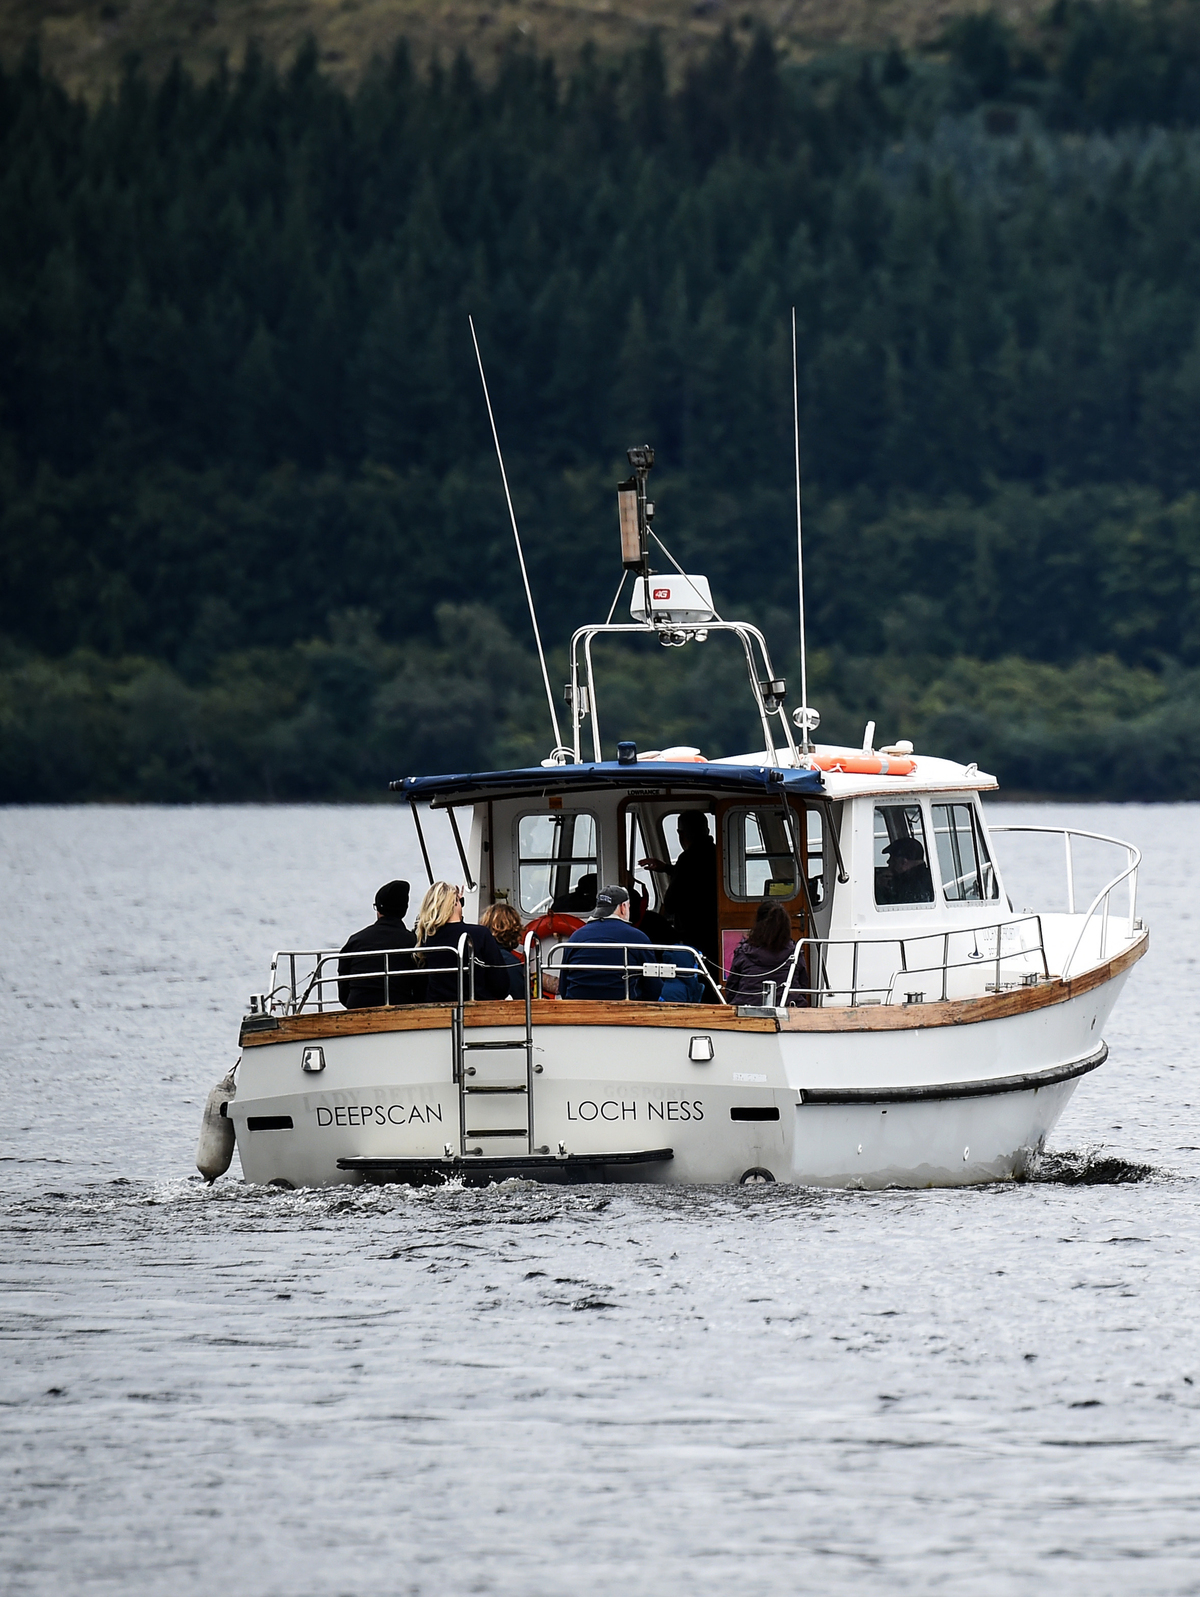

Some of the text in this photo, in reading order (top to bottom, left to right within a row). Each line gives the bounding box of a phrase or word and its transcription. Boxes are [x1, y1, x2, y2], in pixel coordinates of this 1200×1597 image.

[655, 590, 668, 598] 4G
[374, 1086, 435, 1105] BETH
[604, 1085, 687, 1101] GOSPORT
[316, 1103, 443, 1127] DEEPSCAN
[566, 1100, 705, 1121] LOCH NESS
